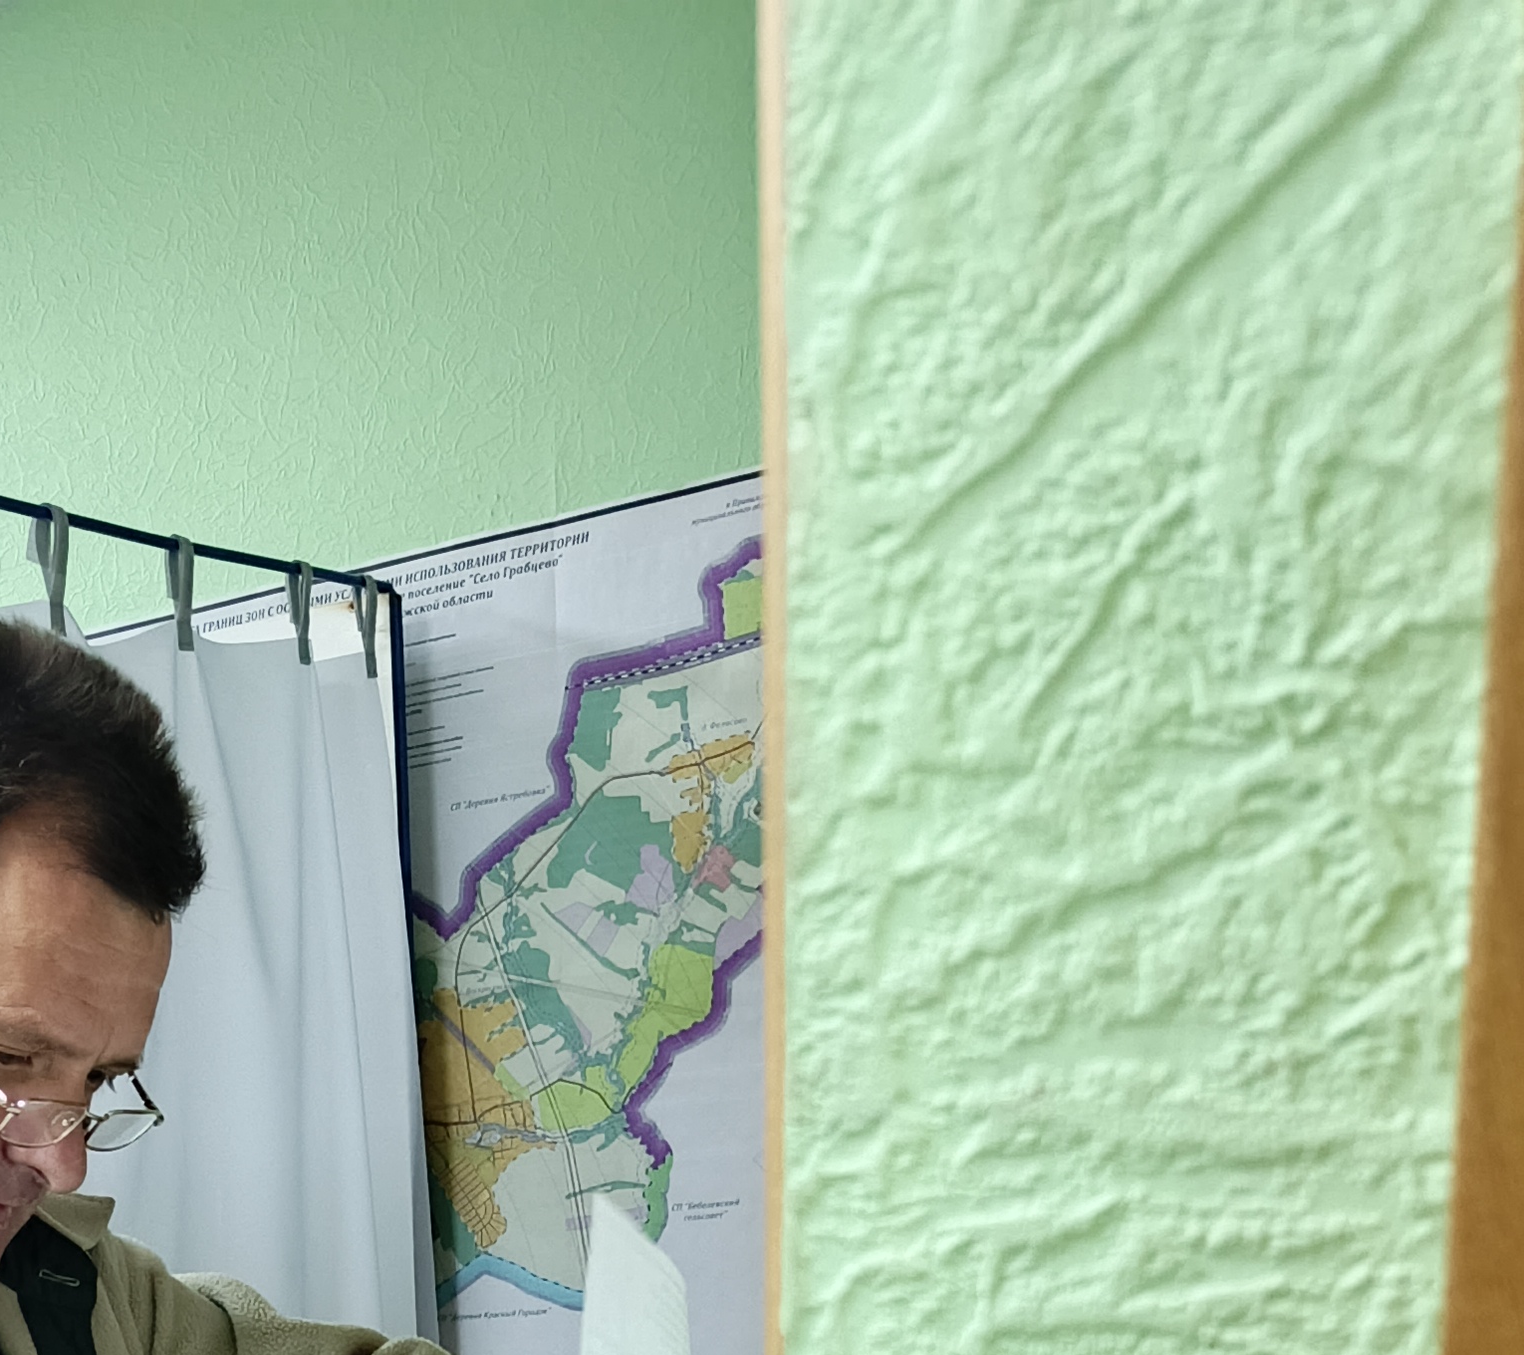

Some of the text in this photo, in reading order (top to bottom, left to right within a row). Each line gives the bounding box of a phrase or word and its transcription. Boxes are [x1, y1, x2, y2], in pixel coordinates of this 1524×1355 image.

[202, 615, 243, 634] ГРАНИЦ
[246, 611, 265, 624] ЗОН
[268, 606, 275, 617] С
[405, 550, 506, 585] ИСПОЛЬЗОВАНИЯ
[510, 531, 590, 561] ТЕРРИТОРИИ
[408, 554, 563, 600] поселение "Село Грабцево"
[443, 589, 494, 607] области
